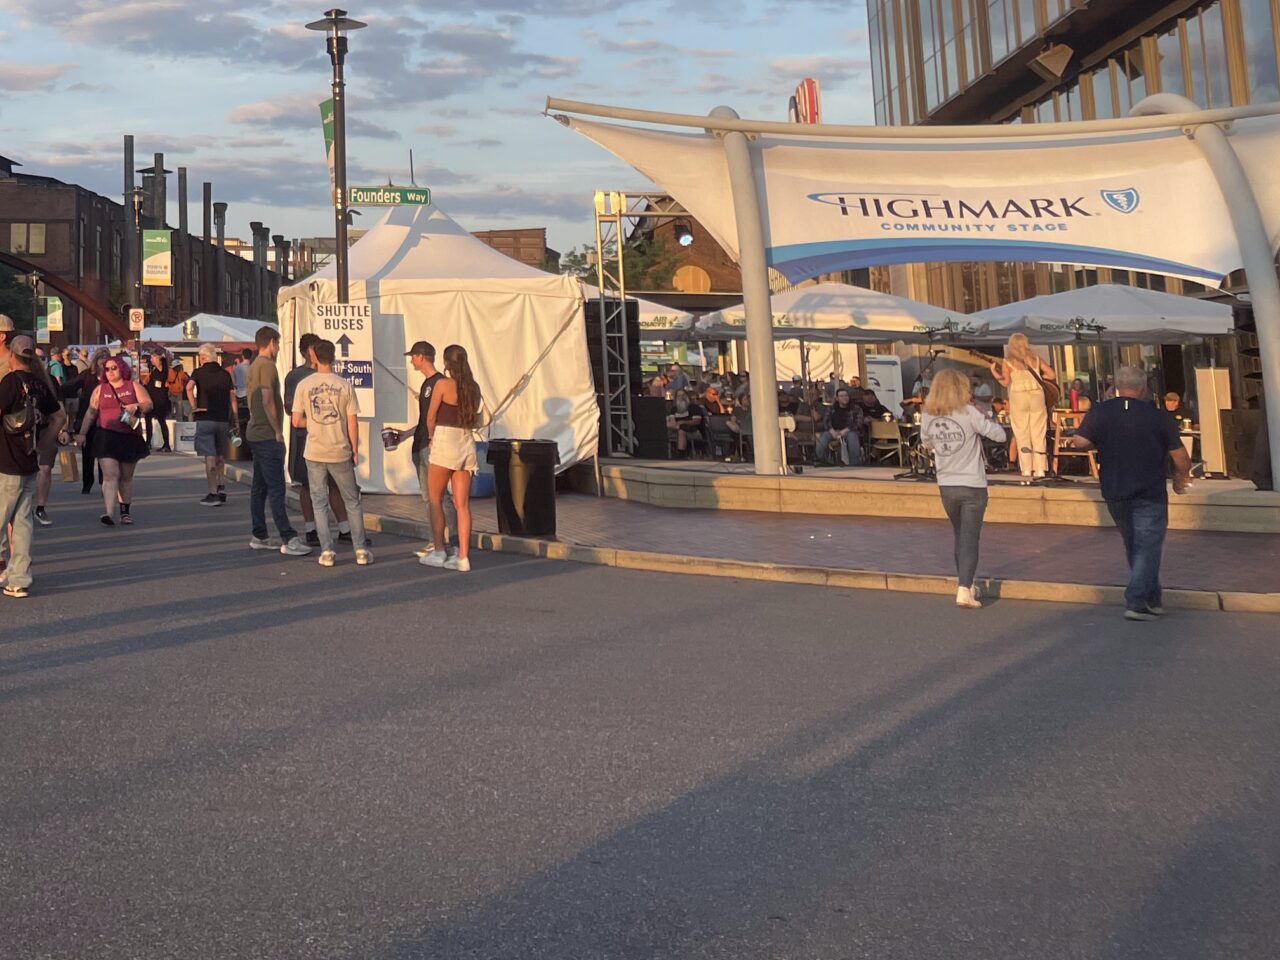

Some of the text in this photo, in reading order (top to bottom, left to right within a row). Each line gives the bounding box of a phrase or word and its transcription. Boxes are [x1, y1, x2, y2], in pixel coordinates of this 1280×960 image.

[351, 189, 426, 203] Founders Way
[837, 196, 1093, 218] HIGHMARK
[881, 222, 1068, 232] COMMUNITY STAGE
[316, 305, 371, 317] SHUTTLE
[324, 318, 364, 330] BUSES
